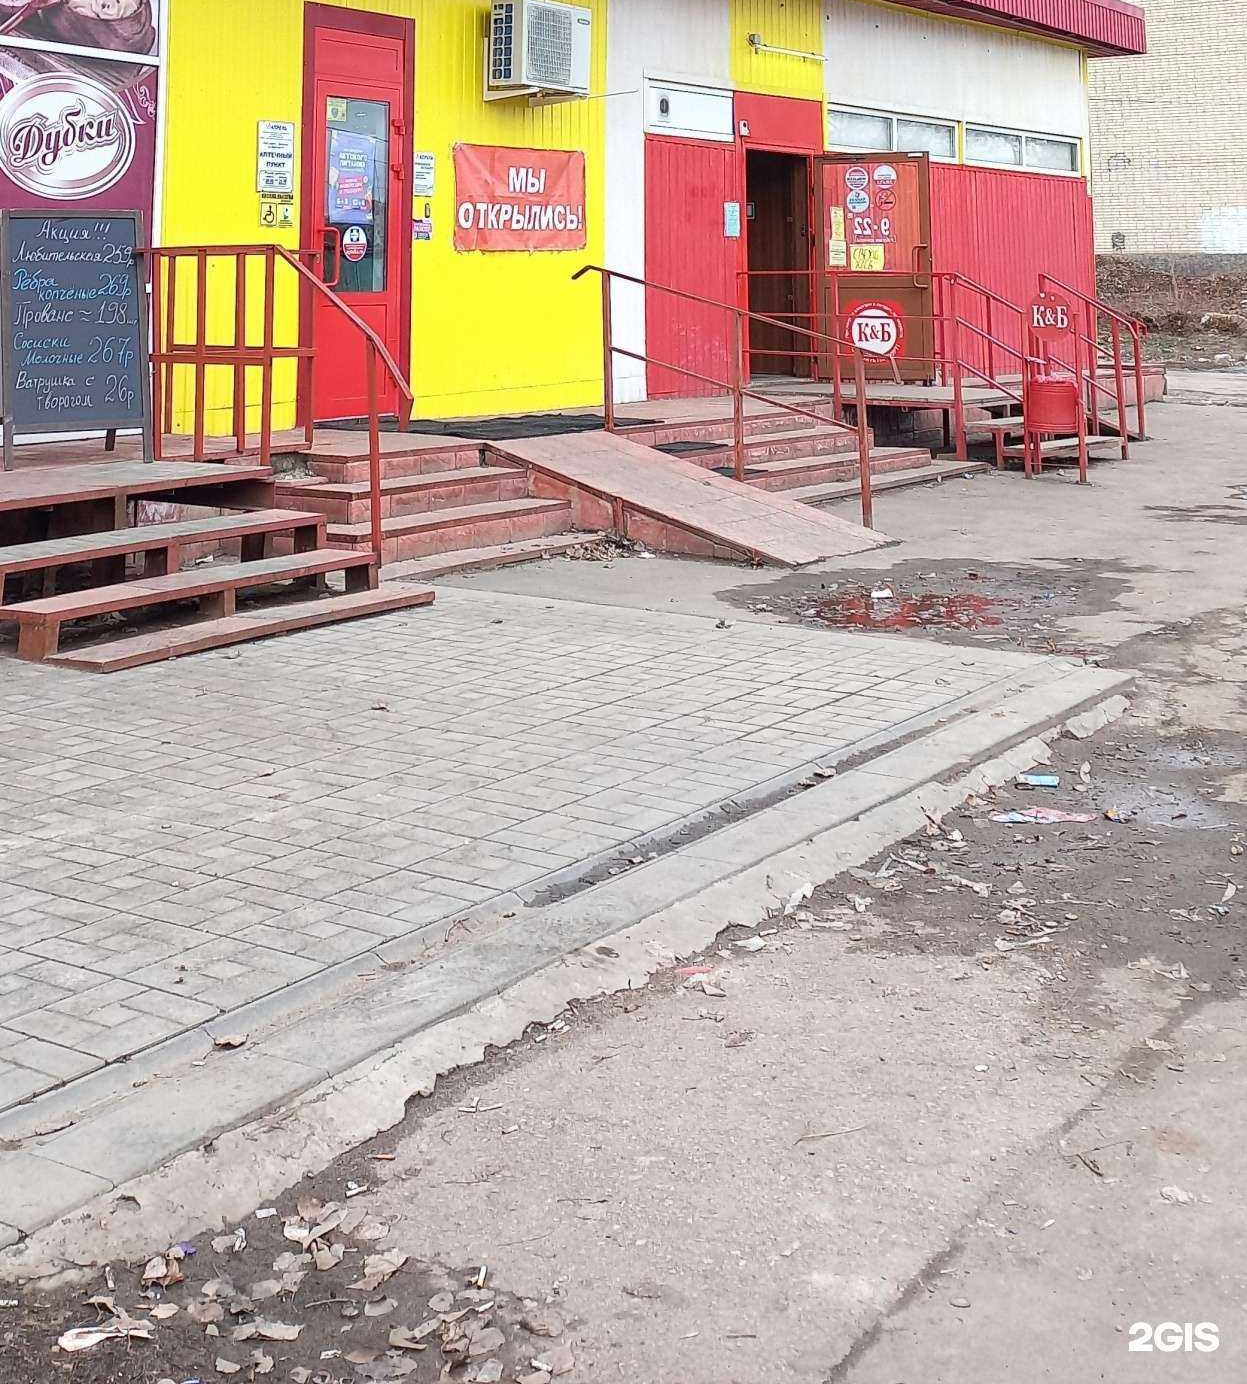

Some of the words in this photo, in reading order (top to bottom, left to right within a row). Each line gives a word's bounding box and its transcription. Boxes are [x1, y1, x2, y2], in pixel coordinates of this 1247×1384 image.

[12, 106, 116, 165] Дубки
[508, 167, 546, 194] МЫ
[458, 202, 583, 230] ОТКРЫЛИСЬ!
[12, 241, 102, 262] Любительская
[14, 300, 74, 327] Прованс
[1032, 305, 1069, 328] К&Б
[13, 332, 71, 350] Сосиски
[857, 322, 891, 342] К&Б
[16, 370, 76, 393] Ватрушка
[37, 392, 93, 412] творогом
